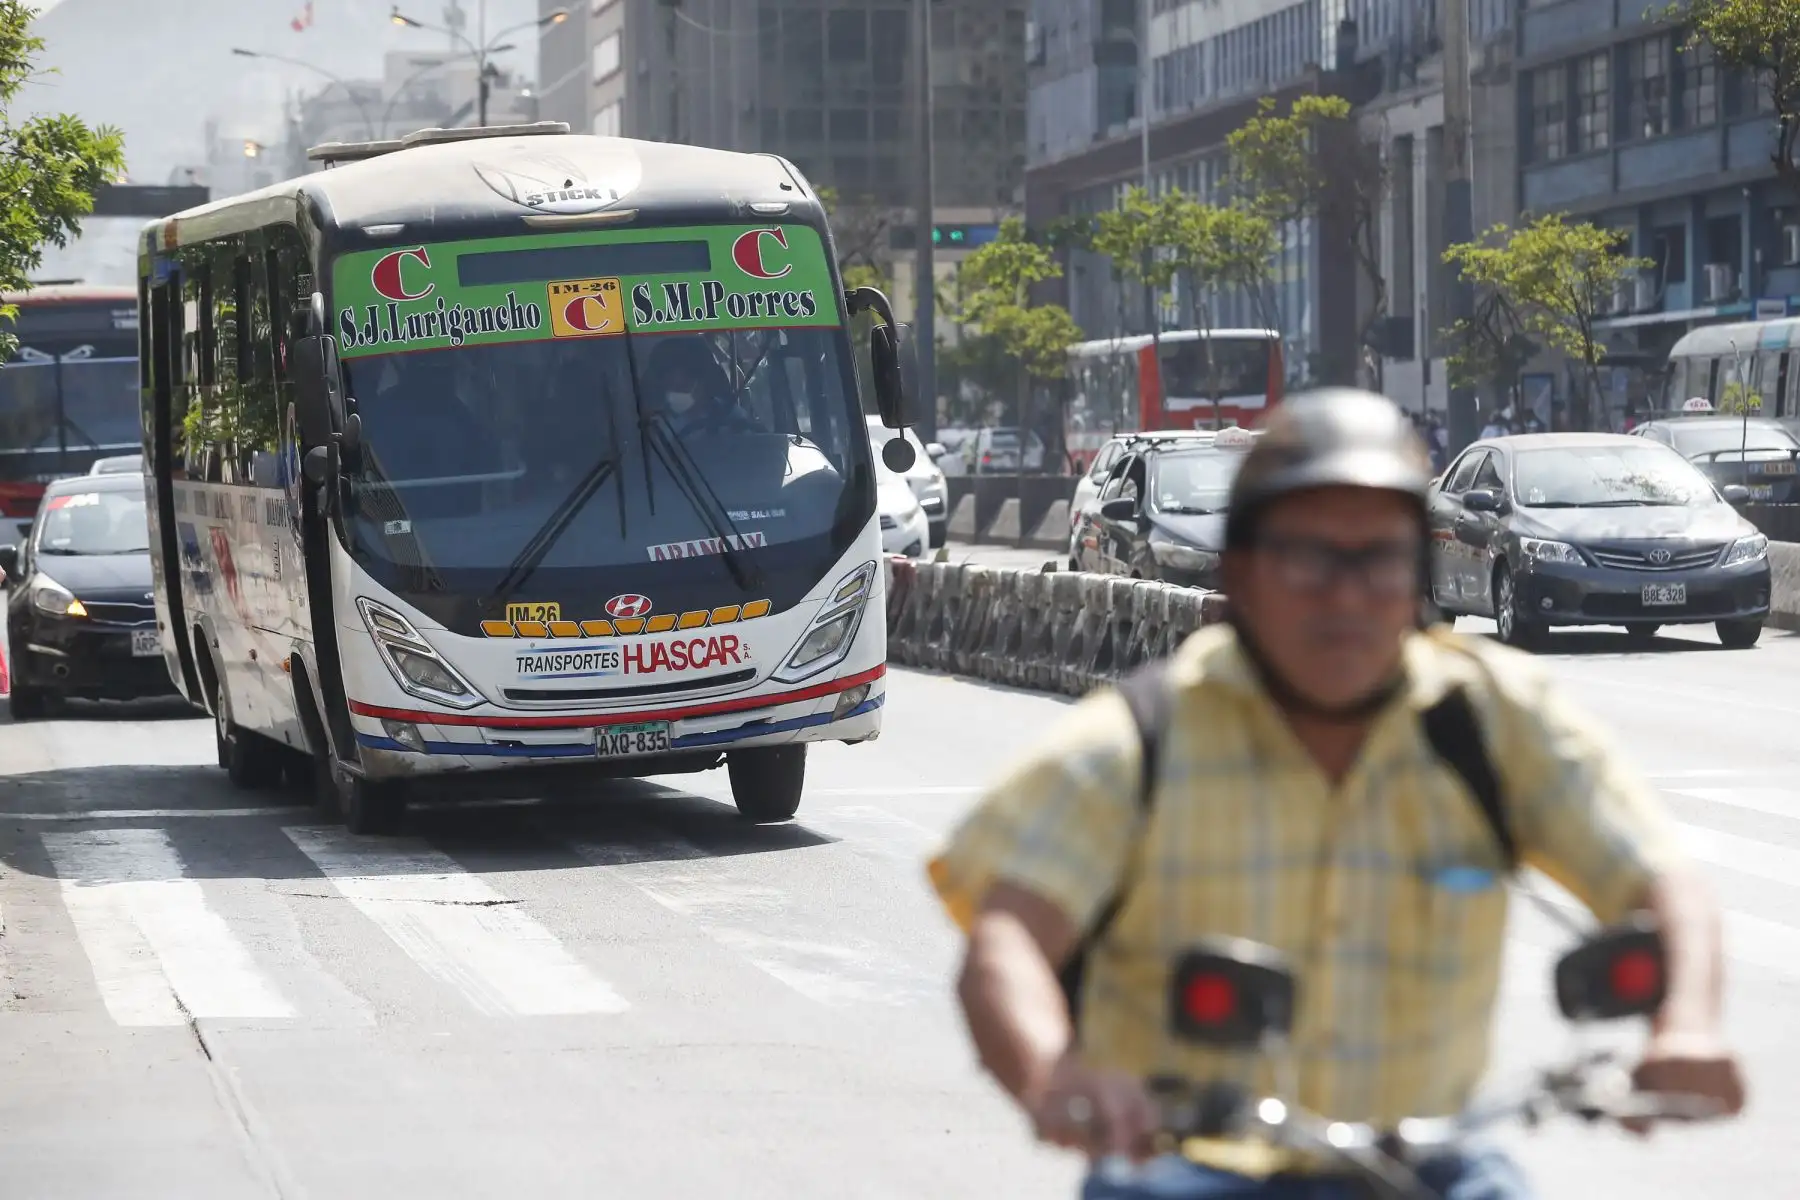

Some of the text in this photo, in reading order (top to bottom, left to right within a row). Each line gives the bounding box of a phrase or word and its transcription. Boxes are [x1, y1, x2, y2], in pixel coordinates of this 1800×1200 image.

[732, 226, 793, 279] C
[371, 246, 435, 301] C
[552, 282, 617, 294] IM-26
[340, 291, 541, 350] S.J.Lurigancho
[564, 293, 609, 332] C
[632, 281, 817, 327] S.M.Porres
[509, 605, 557, 624] IM-26
[516, 635, 741, 674] TRANSPORTES HUASCAR
[599, 730, 667, 755] AXQ-835
